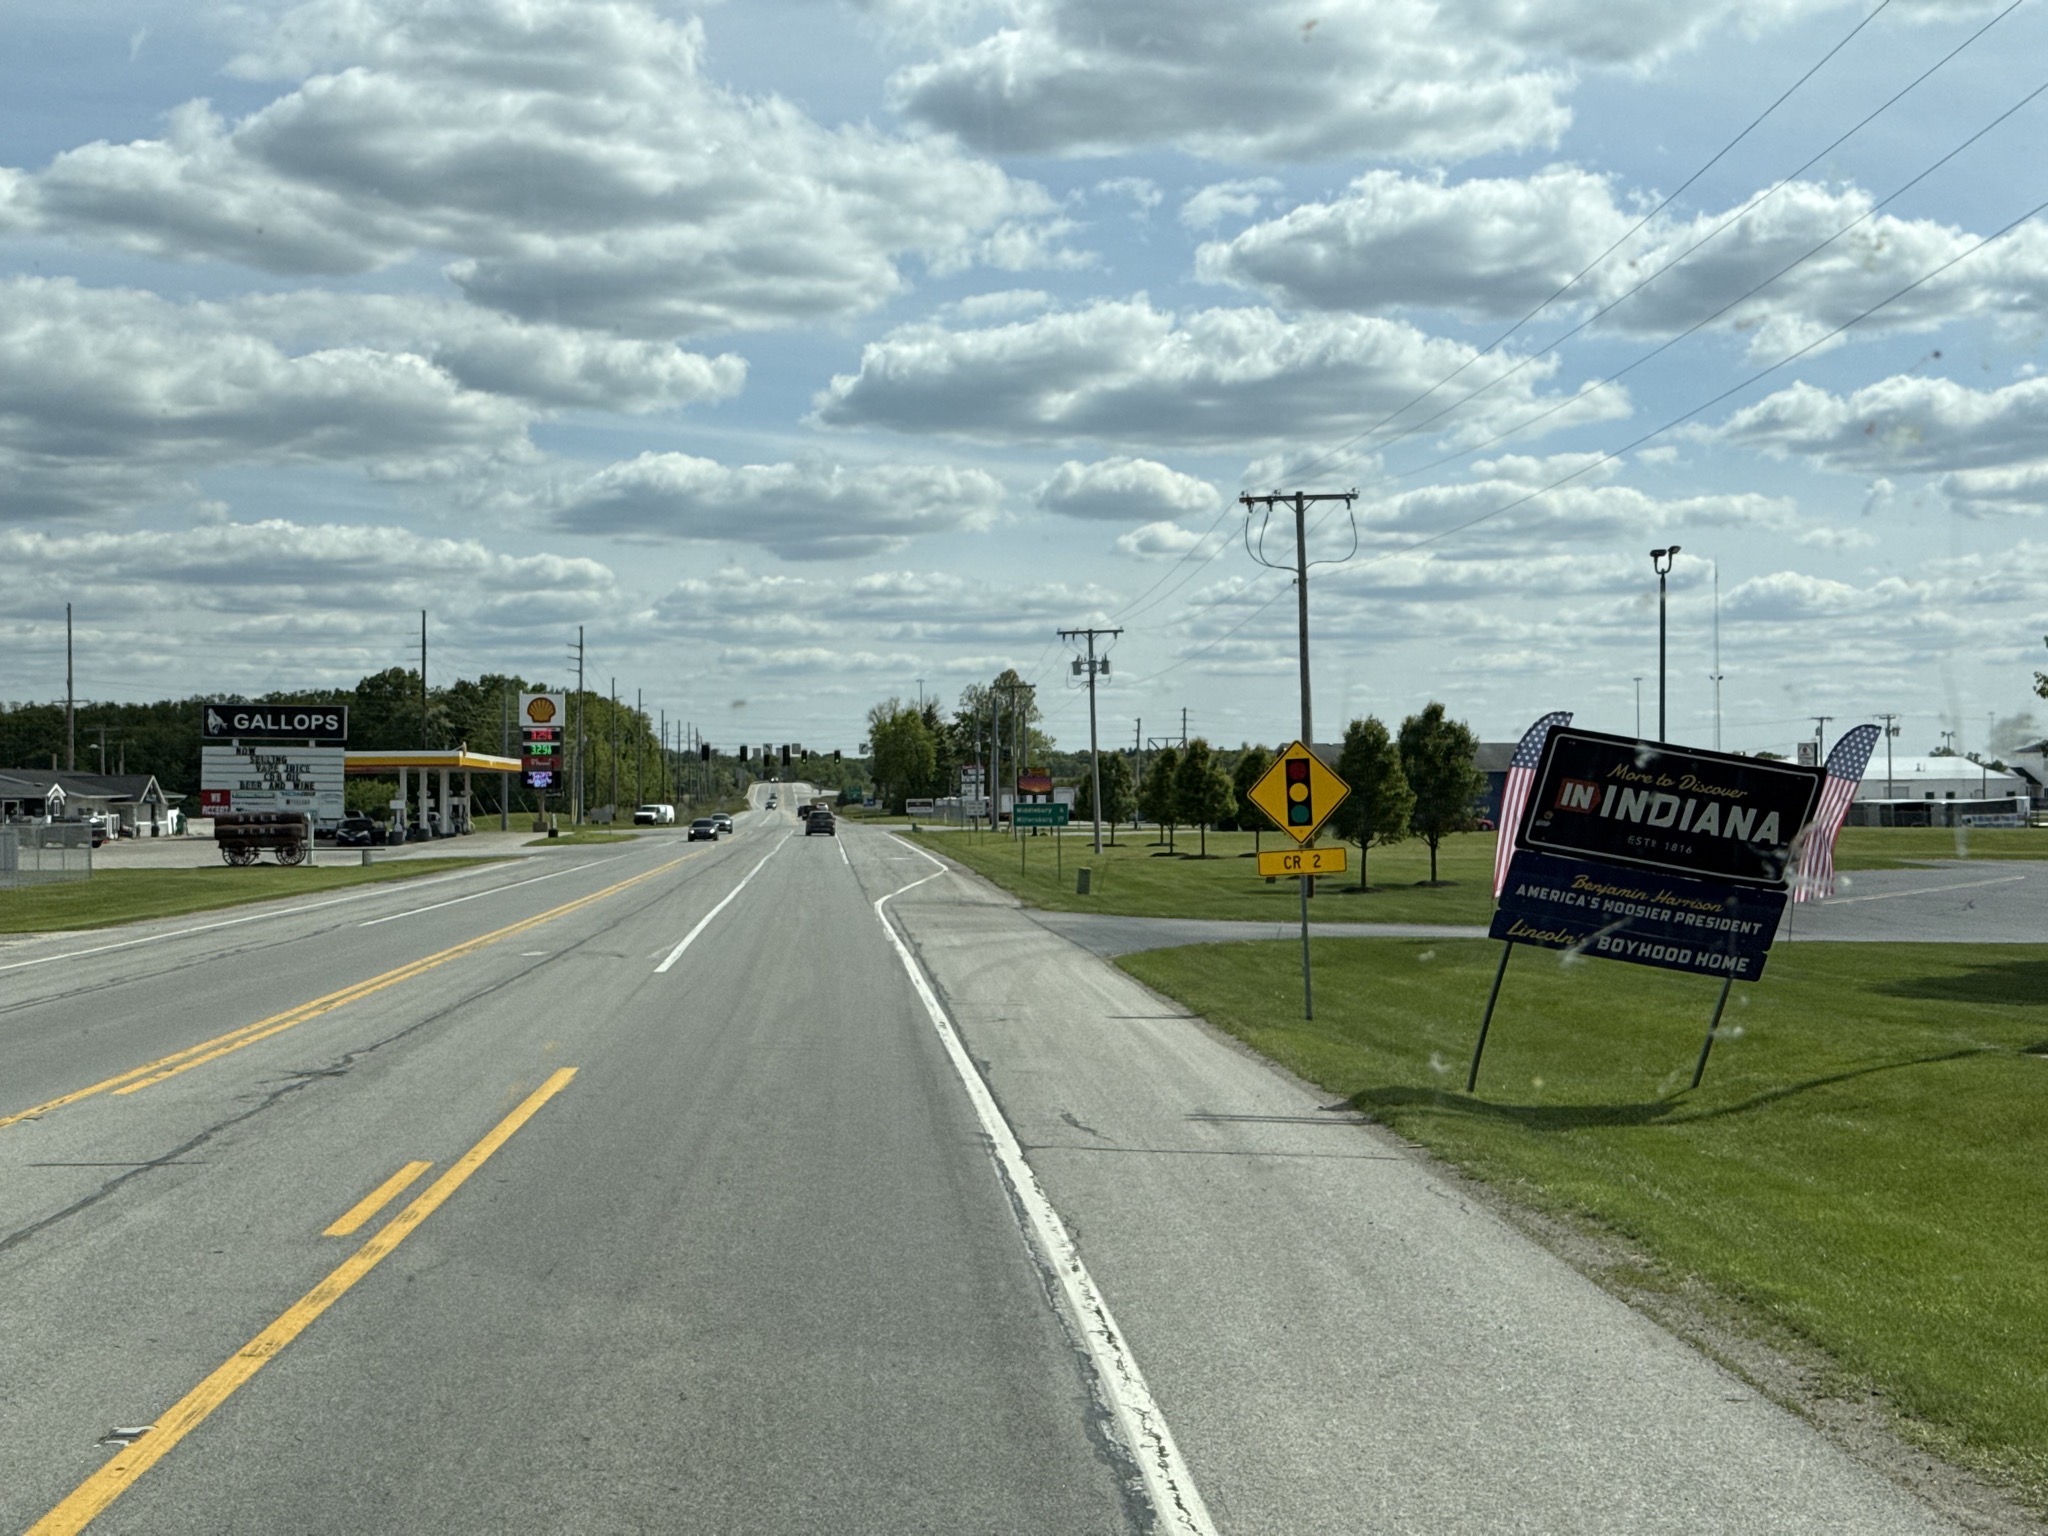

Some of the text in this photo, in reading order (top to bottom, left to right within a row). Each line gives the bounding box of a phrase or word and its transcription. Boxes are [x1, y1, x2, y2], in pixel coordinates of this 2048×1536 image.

[233, 713, 339, 731] GALLOPS
[236, 747, 256, 756] NOW
[250, 755, 287, 764] SELLING
[256, 764, 311, 773] VAPE JUICE
[286, 773, 300, 782] OIL
[1606, 763, 1748, 799] More to Discover
[240, 781, 315, 790] BEER AND WINE
[209, 793, 222, 803] WE
[1560, 783, 1780, 845] IN INDIANA
[1664, 842, 1693, 854] 1816
[1283, 854, 1322, 869] CR 2
[1570, 874, 1724, 912] Benjamin Harrison
[1514, 884, 1762, 935] AMERICA'S HOOSIER PRESIDENT
[1596, 936, 1690, 964] BOYHOOD
[1694, 951, 1750, 972] HOME
